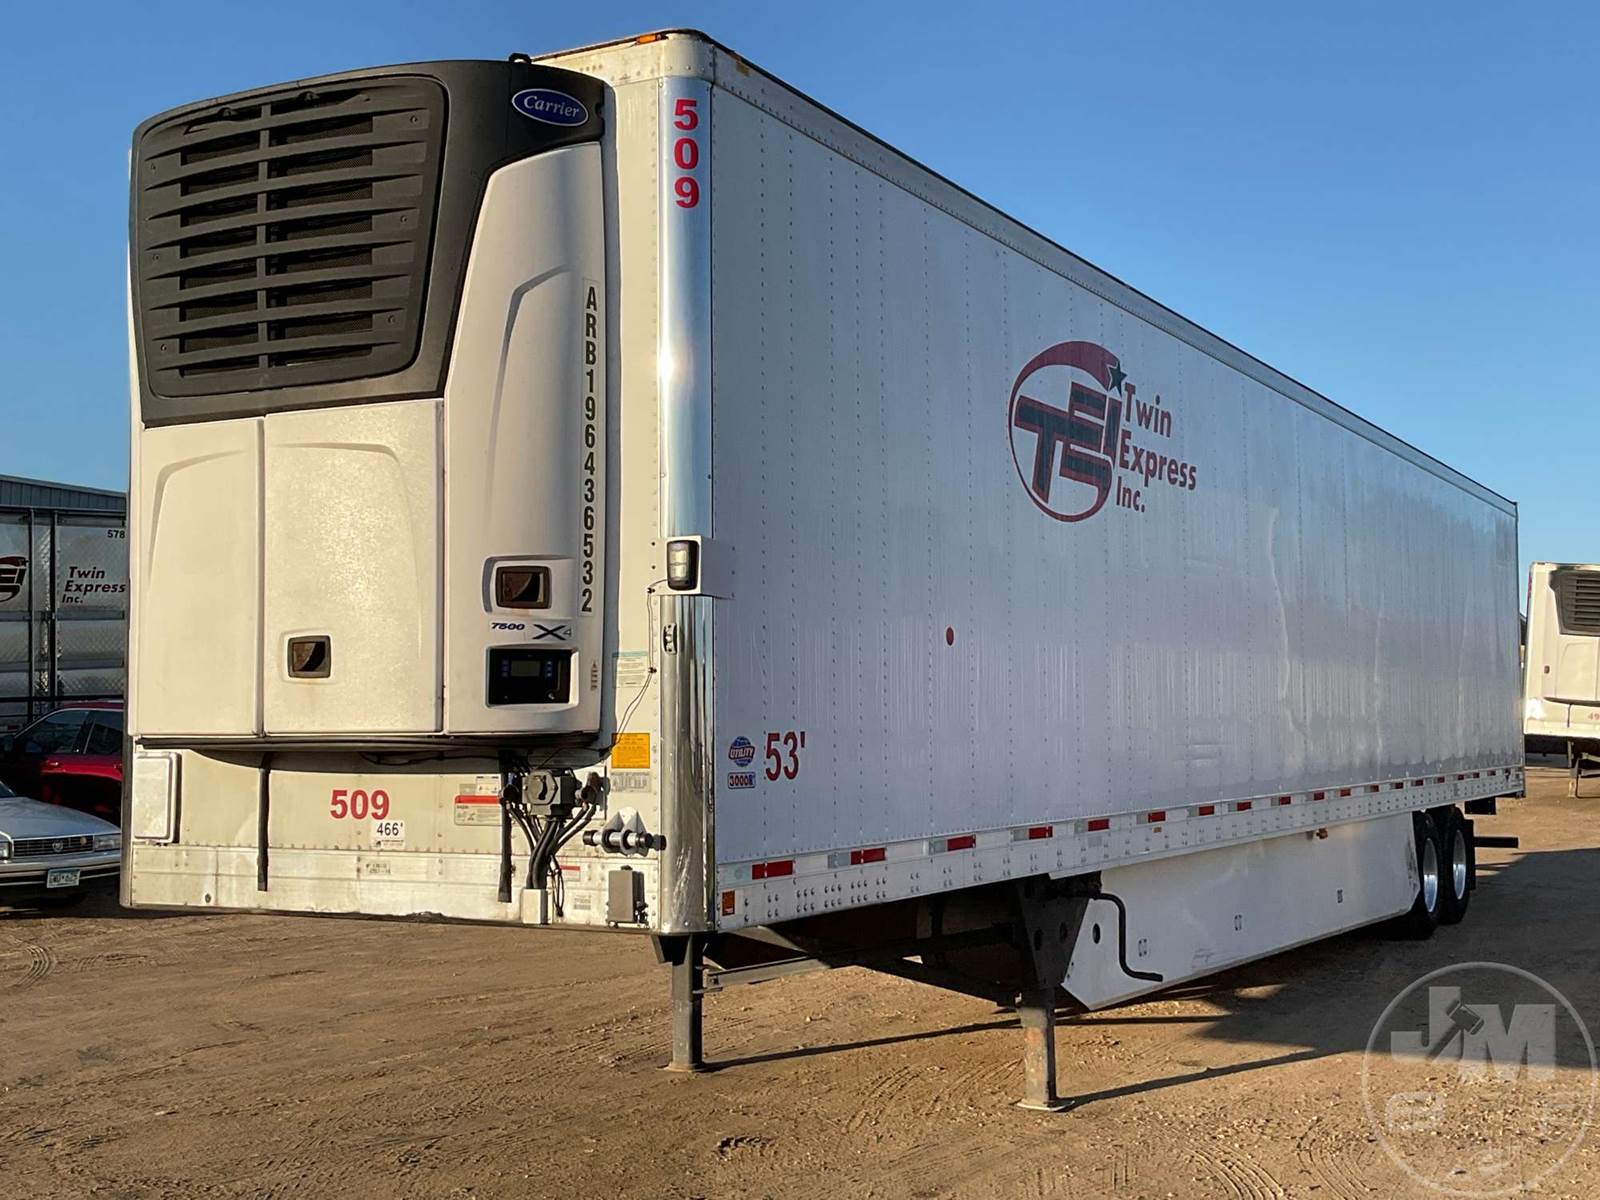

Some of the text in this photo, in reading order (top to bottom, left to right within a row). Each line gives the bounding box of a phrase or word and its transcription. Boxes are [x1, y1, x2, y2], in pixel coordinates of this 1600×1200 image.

[523, 95, 580, 118] Carrier
[673, 98, 701, 209] 509
[1123, 382, 1172, 438] Twin
[581, 286, 598, 613] ARB196436532
[1119, 429, 1197, 491] Express
[1115, 476, 1146, 513] Inc.
[106, 529, 126, 539] 578
[64, 580, 127, 596] Express
[68, 566, 106, 579] Twin
[61, 594, 84, 604] Inc.
[491, 622, 526, 631] 7500
[765, 730, 806, 782] 53'
[330, 789, 390, 820] 509
